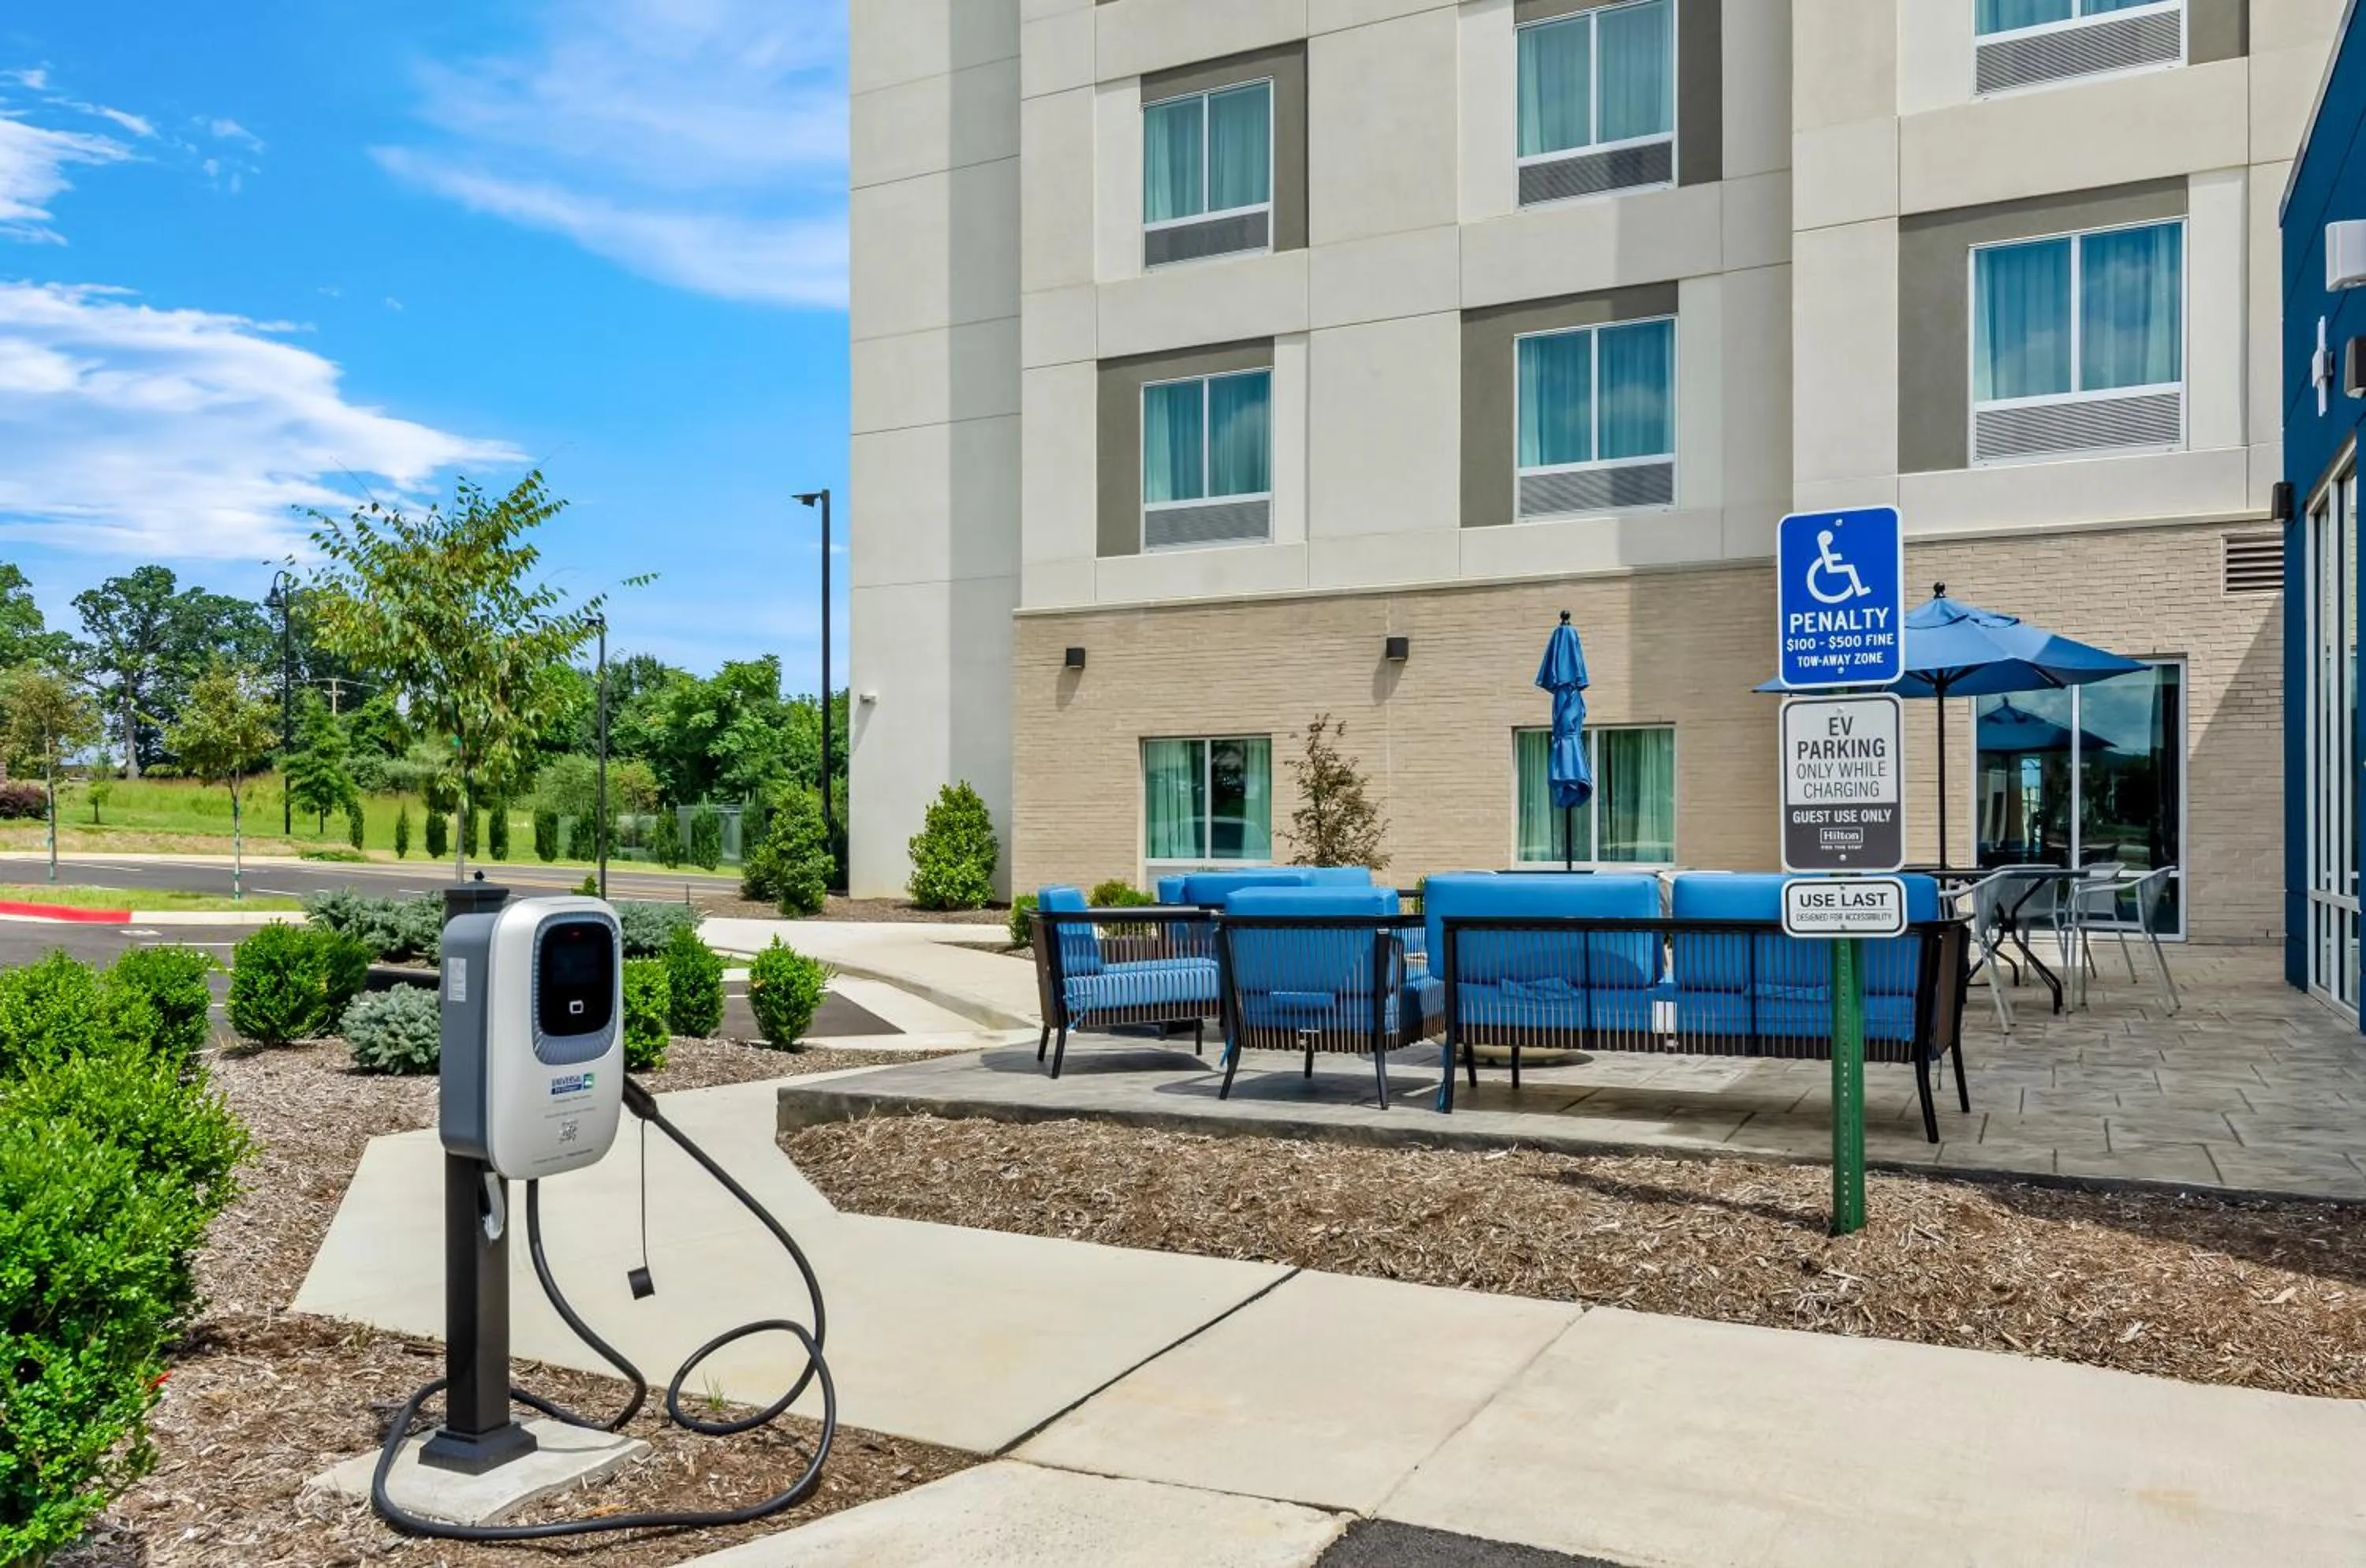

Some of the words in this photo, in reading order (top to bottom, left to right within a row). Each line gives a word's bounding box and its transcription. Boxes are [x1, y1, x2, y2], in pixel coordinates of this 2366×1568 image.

[1789, 607, 1889, 634] PENALTY
[1786, 638, 1816, 652] $100
[1829, 635, 1862, 650] $500
[1865, 633, 1894, 646] FINE
[1797, 653, 1851, 668] TOW-AWAY
[1854, 651, 1884, 665] ZONE
[1829, 716, 1853, 736] EV
[1797, 737, 1886, 760] PARKING
[1797, 762, 1834, 780] ONLY
[1838, 760, 1887, 778] WHILE
[1804, 780, 1879, 799] CHARGING
[1793, 810, 1830, 823] GUEST
[1834, 810, 1858, 823] USE
[1860, 809, 1892, 823] ONLY
[1823, 831, 1859, 840] Hilton
[1800, 894, 1835, 907] USE
[1842, 892, 1888, 906] LAST
[1830, 913, 1842, 921] FOR
